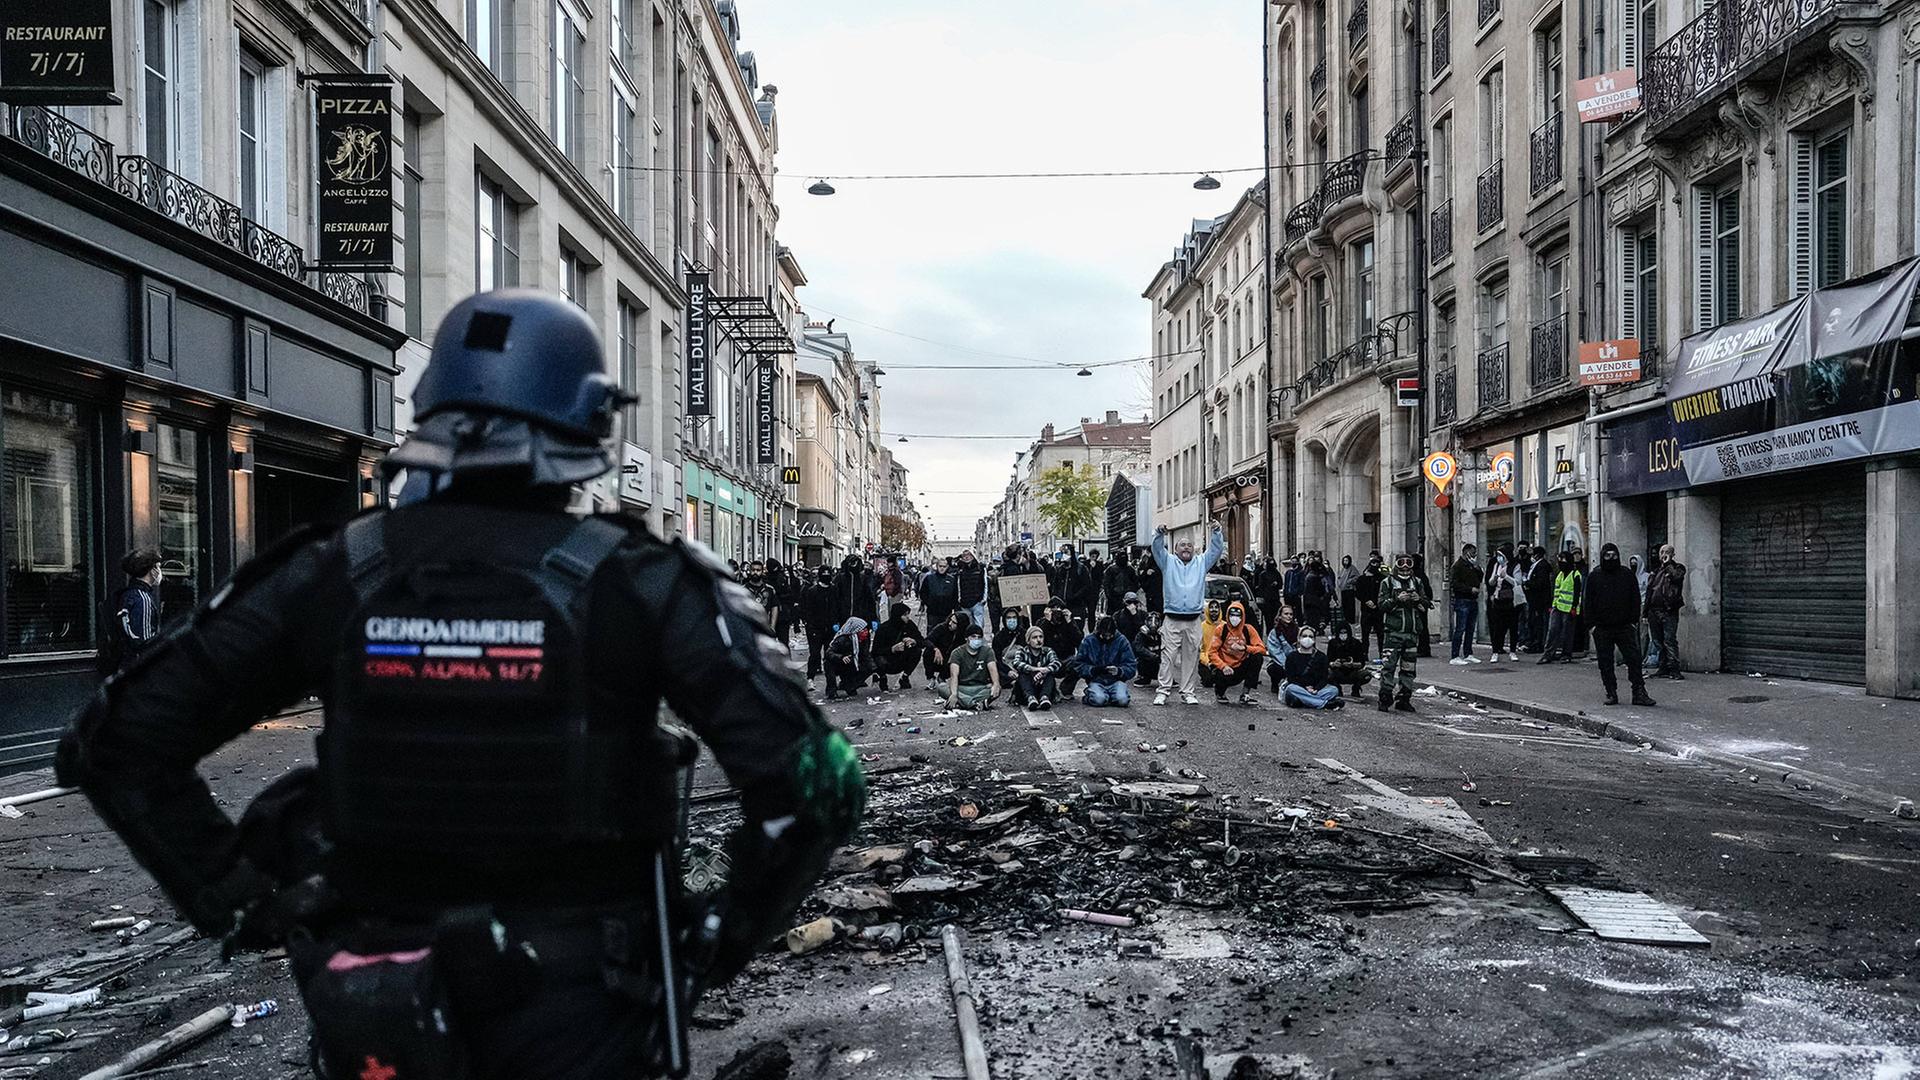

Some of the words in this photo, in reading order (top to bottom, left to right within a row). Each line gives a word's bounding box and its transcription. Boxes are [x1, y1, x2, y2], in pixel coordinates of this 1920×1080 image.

[6, 26, 106, 41] RESTAURANT
[321, 99, 389, 115] PIZZA
[1585, 101, 1593, 109] A
[1594, 90, 1632, 106] VENDRE
[323, 186, 389, 197] ANGELÙZZO
[324, 222, 389, 233] RESTAURANT
[691, 283, 704, 331] LIVRE
[691, 335, 704, 359] DU
[1688, 332, 1743, 369] FITNESS
[1739, 319, 1781, 350] PARK
[1587, 365, 1594, 373] A
[1596, 361, 1633, 372] VENDRE
[691, 362, 705, 405] HALL
[761, 367, 771, 402] LIVRE
[1672, 389, 1721, 423] OUVERTURE
[1721, 373, 1777, 411] PROCHAINE
[761, 405, 771, 422] DU
[761, 424, 771, 457] HALL
[1736, 439, 1773, 458] FITNESS
[1787, 428, 1816, 448] NANCY
[1818, 420, 1862, 442] CENTRE
[1649, 439, 1669, 473] LES
[1809, 445, 1834, 459] NANCY
[1032, 590, 1045, 600] US
[364, 616, 545, 645] GENDARMERIE
[422, 662, 492, 681] ALPHA
